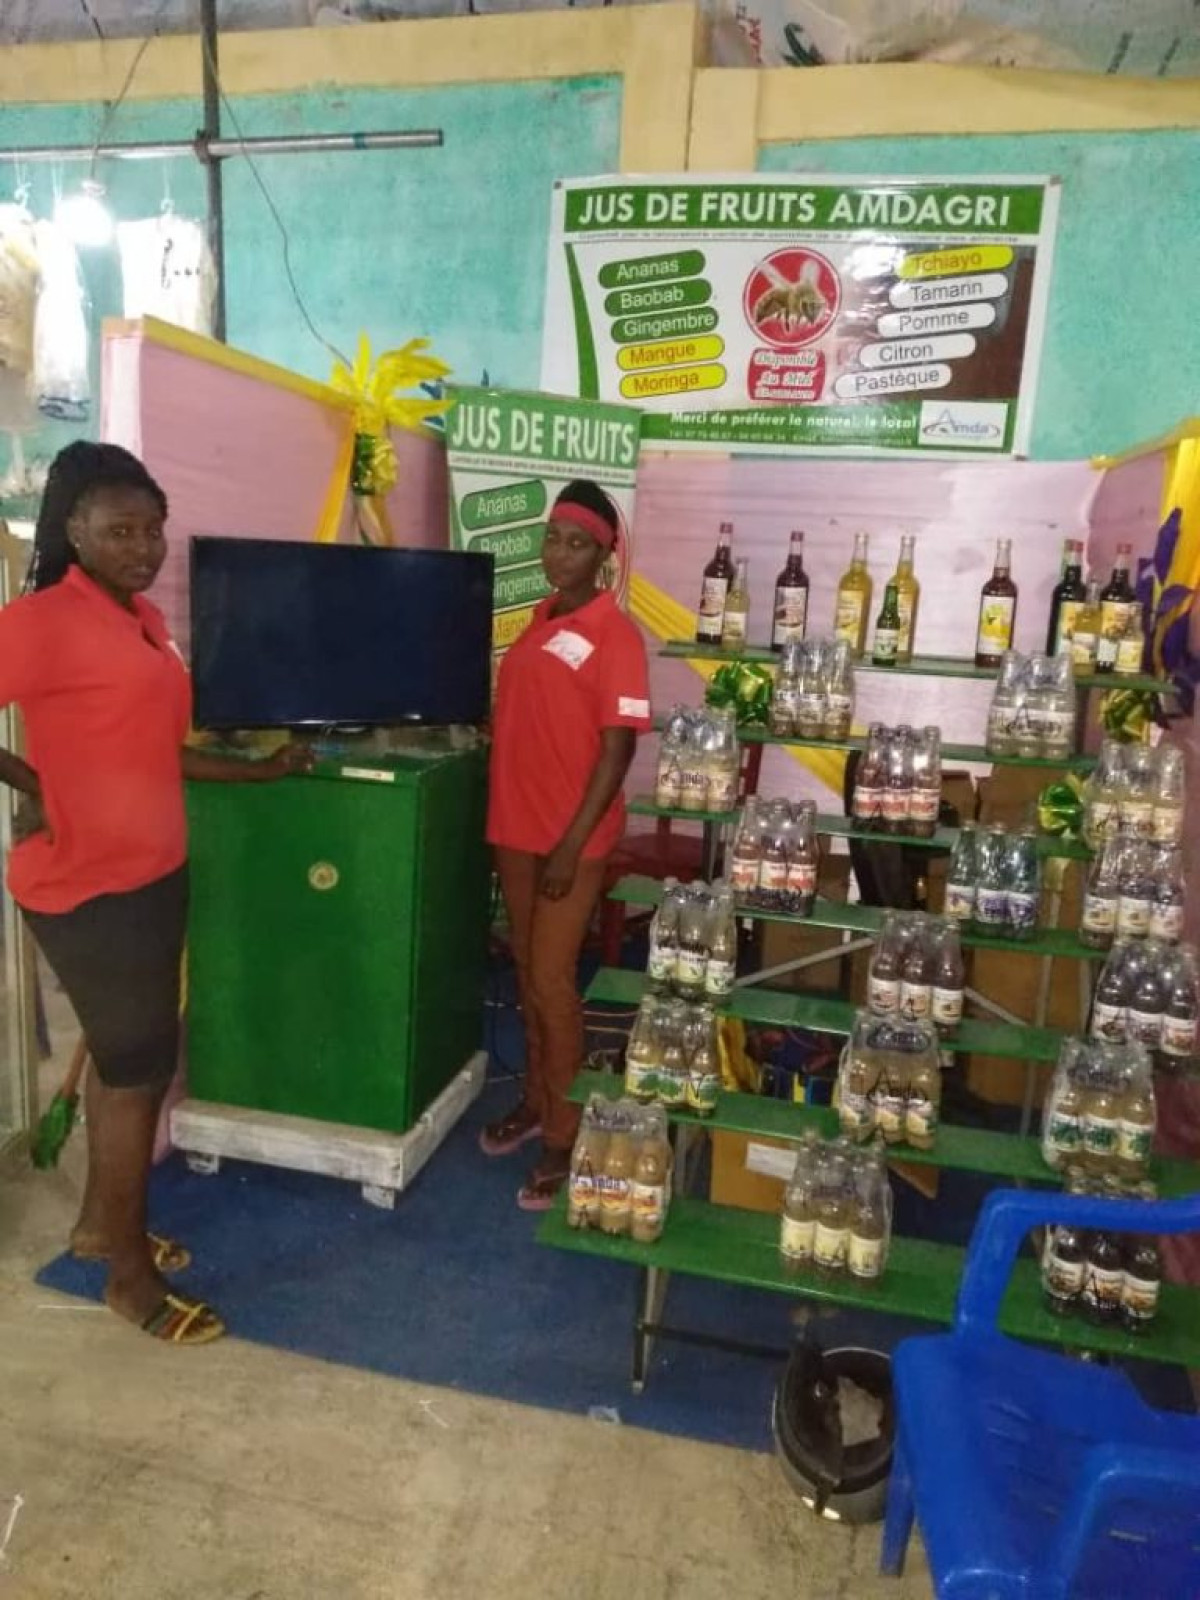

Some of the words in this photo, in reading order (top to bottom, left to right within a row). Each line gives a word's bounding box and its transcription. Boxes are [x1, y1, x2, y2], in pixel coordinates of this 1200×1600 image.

[578, 193, 634, 225] JUS
[646, 192, 689, 222] DE
[700, 191, 816, 223] FRUITS
[828, 193, 1011, 227] AMDAGRI
[616, 259, 679, 281] Ananas
[621, 285, 684, 310] Baobab
[910, 280, 983, 301] Tamarin
[624, 313, 716, 337] Gingembre
[899, 311, 970, 333] Pomme
[630, 343, 697, 365] Mangue
[879, 343, 934, 363] Citron
[633, 372, 699, 394] Moringa
[855, 367, 940, 392] Pastèque
[671, 411, 706, 425] Merci
[711, 412, 727, 425] de
[452, 403, 500, 449] JUS
[510, 410, 545, 454] DE
[552, 414, 635, 465] FRUITS
[478, 493, 528, 518] Ananas
